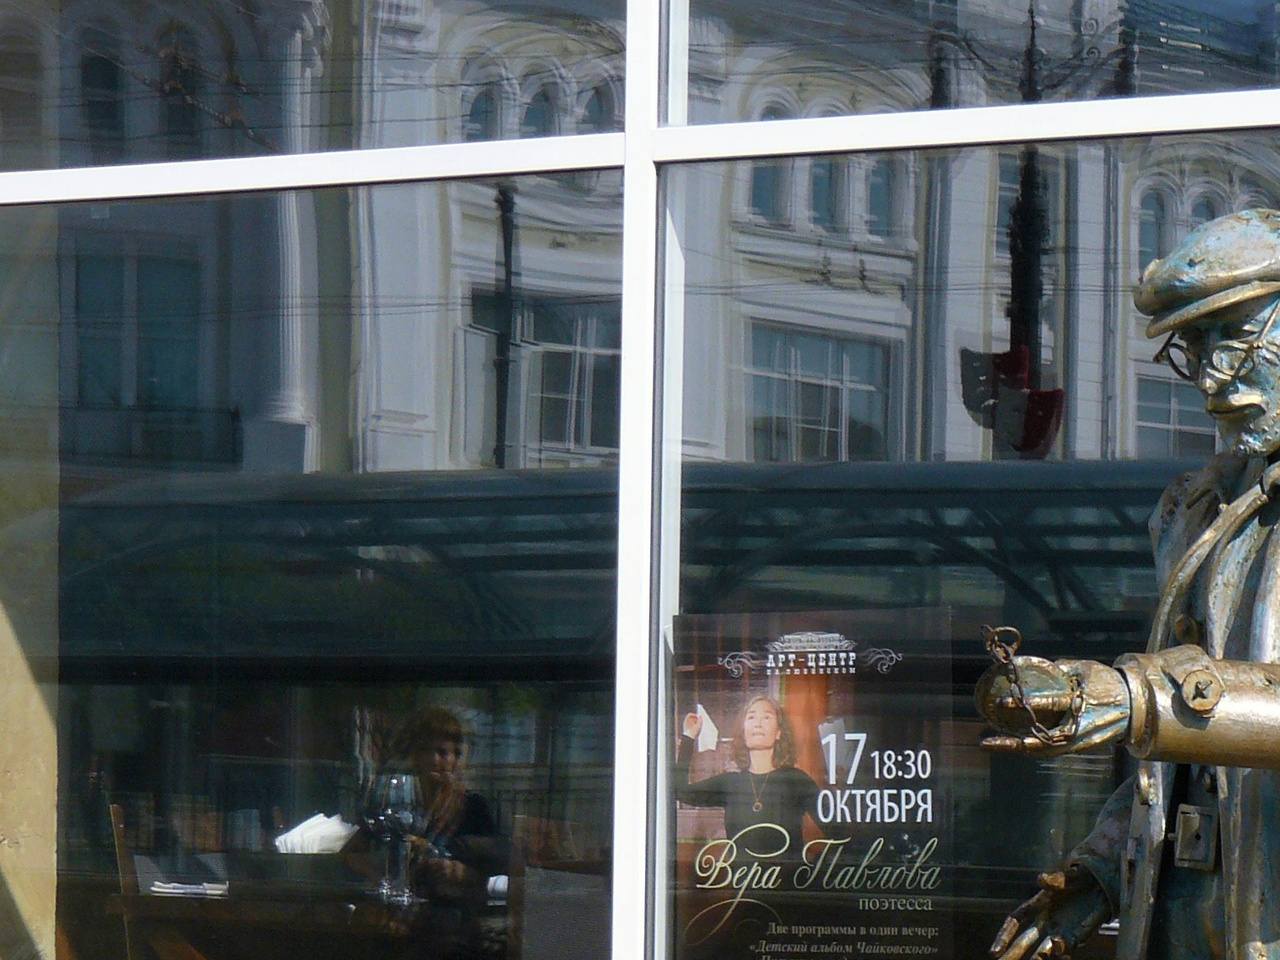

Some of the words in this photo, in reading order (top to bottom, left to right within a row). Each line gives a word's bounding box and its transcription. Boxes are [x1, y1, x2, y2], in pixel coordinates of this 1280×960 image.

[766, 652, 857, 668] АРТ-ЦЕНТР
[821, 733, 867, 785] 17
[871, 749, 931, 779] 18:30
[817, 789, 932, 823] ОКТЯБРЯ
[684, 823, 790, 930] Вера
[793, 837, 942, 890] Павлова
[858, 896, 932, 912] поэтесса
[766, 922, 789, 936] Две
[791, 925, 857, 938] программы
[860, 927, 867, 935] в
[870, 926, 898, 936] один
[901, 927, 939, 939] вечер:
[810, 943, 852, 954] альбом
